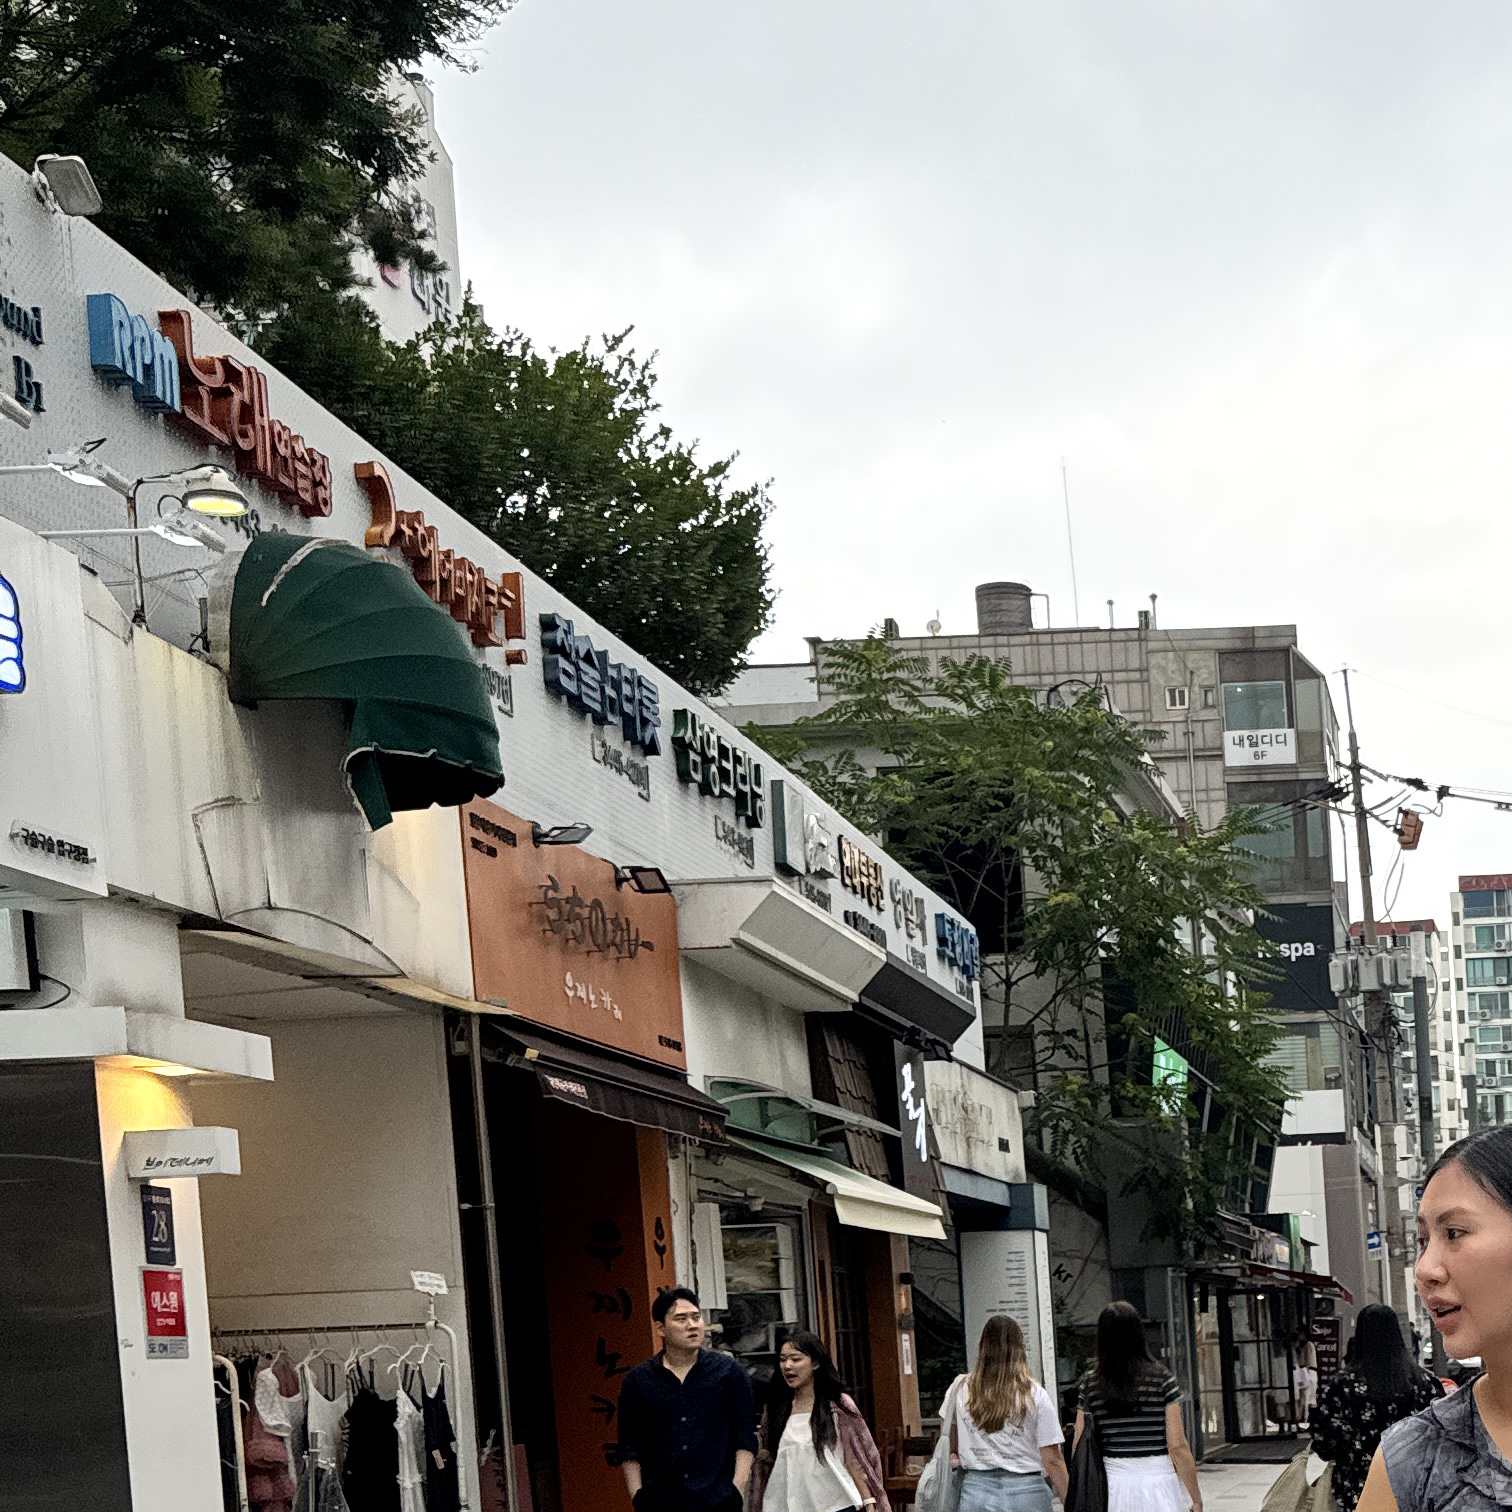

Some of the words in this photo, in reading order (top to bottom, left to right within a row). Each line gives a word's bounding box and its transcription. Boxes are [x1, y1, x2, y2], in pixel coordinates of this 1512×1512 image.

[1232, 732, 1287, 748] 내일디디
[672, 708, 766, 828] 삼영크리닝
[1253, 750, 1268, 761] 6F
[151, 1209, 168, 1243] 28
